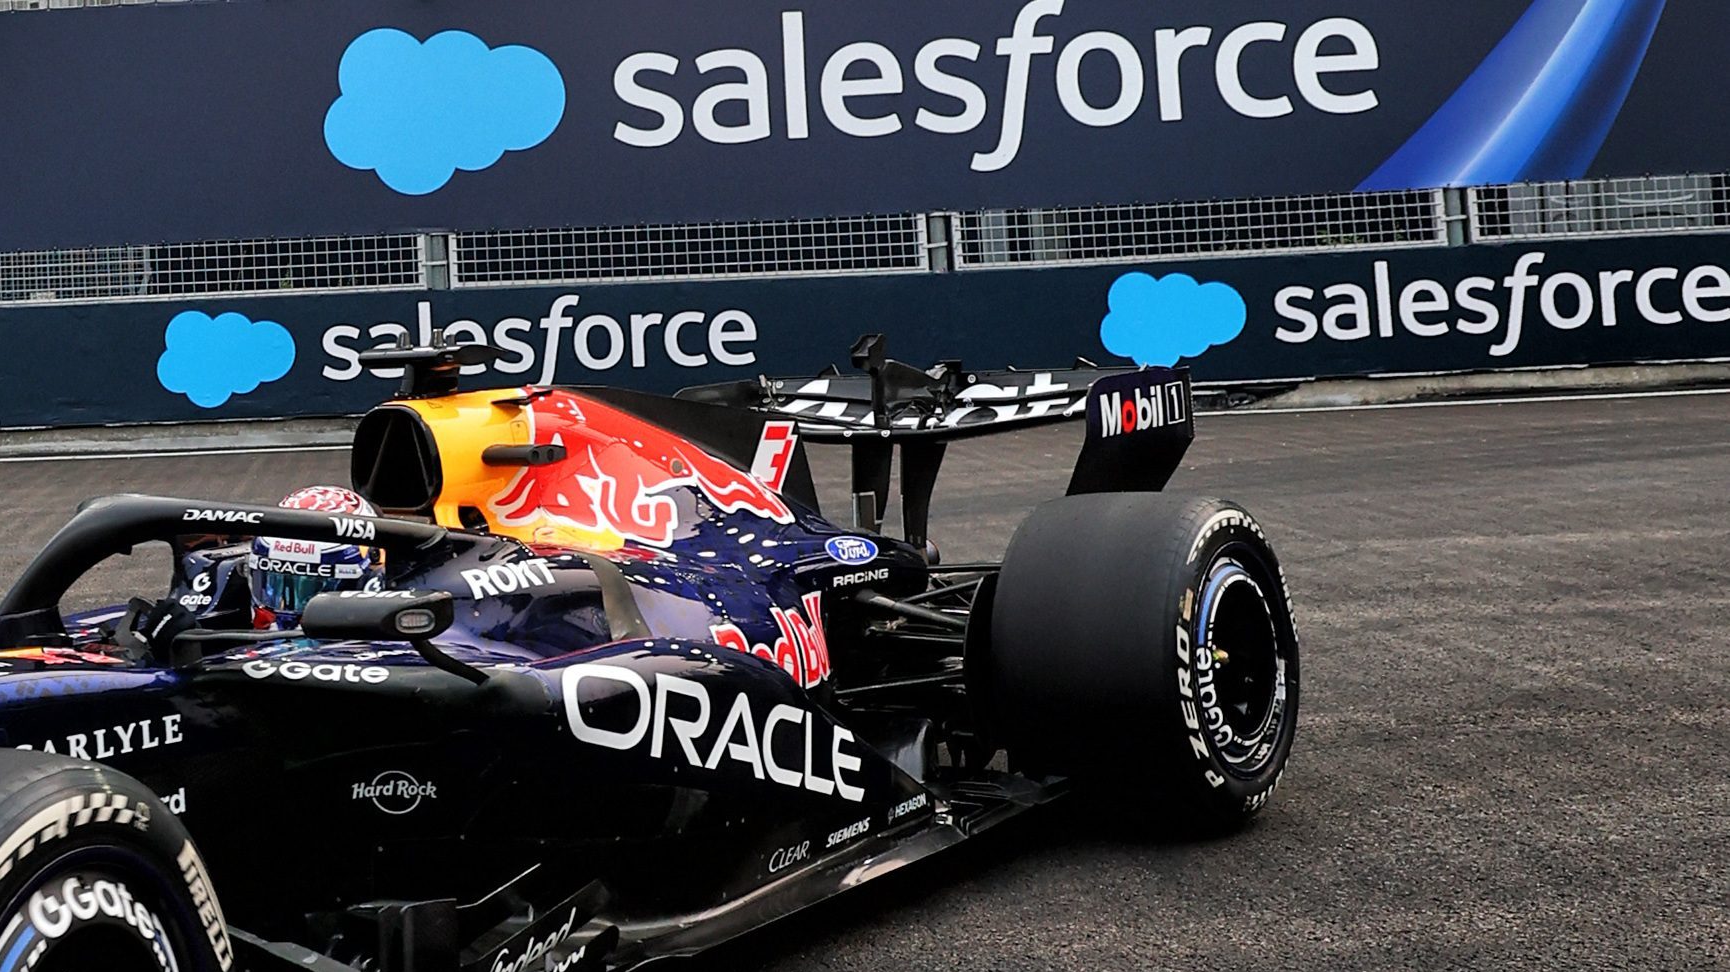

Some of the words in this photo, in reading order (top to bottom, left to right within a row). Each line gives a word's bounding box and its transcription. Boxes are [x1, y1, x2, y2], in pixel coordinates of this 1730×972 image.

[613, 0, 1379, 172] salesforce
[1274, 252, 1730, 356] salesforce
[1099, 384, 1164, 438] Mobil
[182, 508, 265, 524] DAMAC
[328, 516, 377, 541] VISA
[273, 540, 293, 553] Red
[294, 543, 316, 555] Bull
[258, 558, 332, 577] ORACLE
[460, 558, 556, 600] ROKT
[1175, 624, 1211, 760] ZERO
[16, 713, 184, 761] RLYLE
[561, 663, 866, 802] ORACLE
[351, 780, 395, 800] Hard
[396, 779, 438, 799] Rock
[894, 792, 928, 819] HEXAGON
[825, 816, 871, 848] SIEMENS
[768, 839, 811, 873] CLEAR
